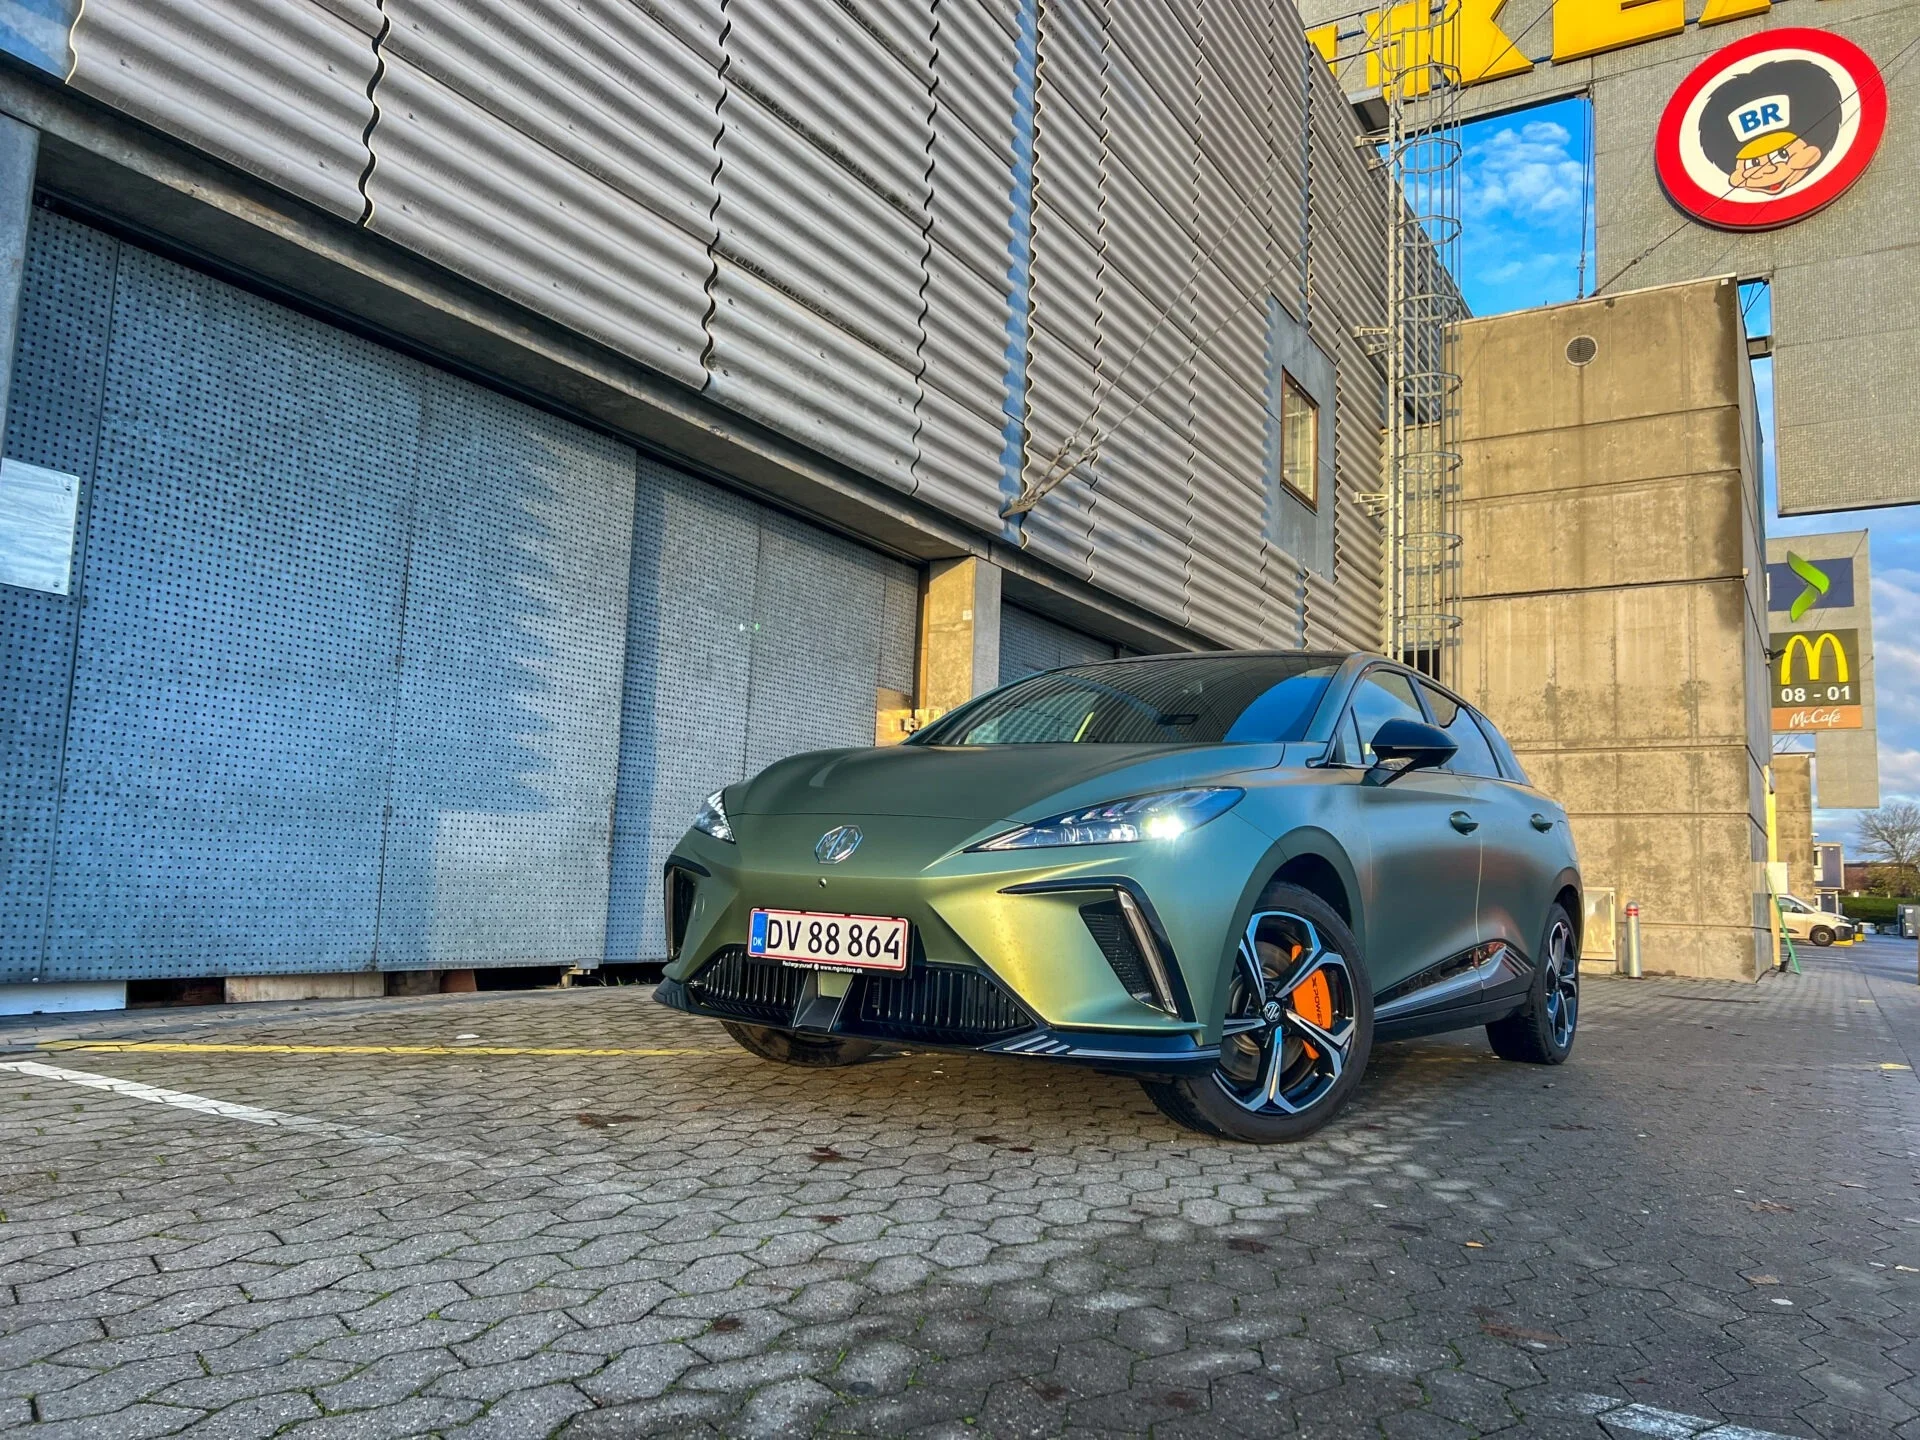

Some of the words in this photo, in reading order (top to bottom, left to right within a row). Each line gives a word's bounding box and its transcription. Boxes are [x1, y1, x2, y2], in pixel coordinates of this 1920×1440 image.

[1738, 103, 1784, 134] BR
[1781, 687, 1806, 702] 08
[1827, 685, 1850, 701] 01
[1789, 708, 1841, 728] McCafé
[752, 936, 763, 947] DK
[767, 919, 802, 951] DV
[808, 921, 840, 955] 88
[847, 924, 900, 960] 864
